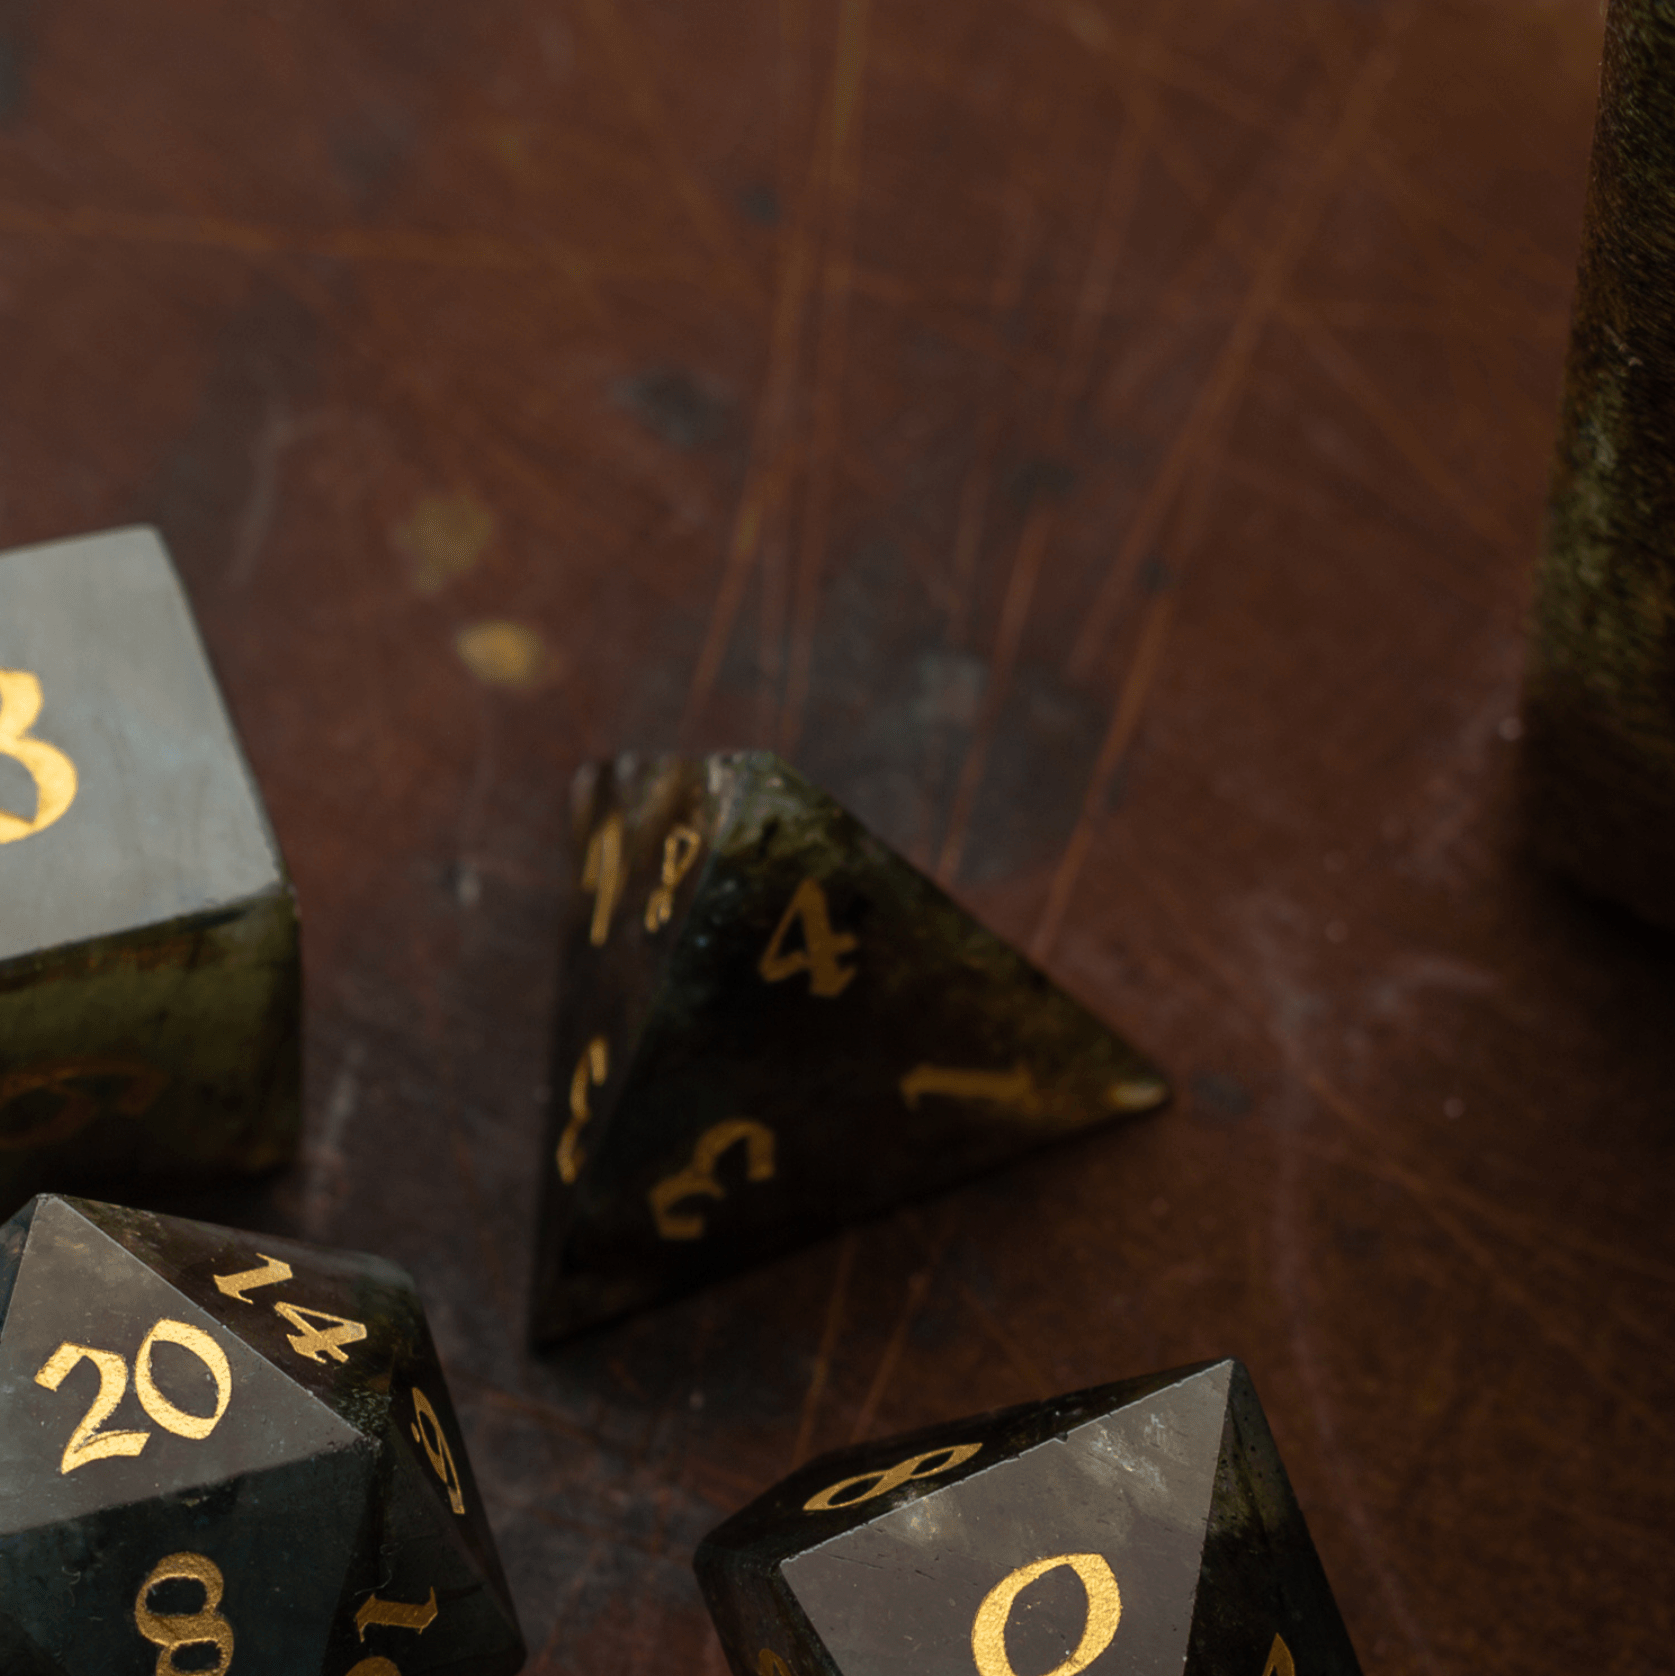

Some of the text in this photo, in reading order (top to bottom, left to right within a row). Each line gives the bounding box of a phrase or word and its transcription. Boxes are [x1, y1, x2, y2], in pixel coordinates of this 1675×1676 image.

[758, 876, 859, 997] 4
[647, 1118, 776, 1240] 3
[213, 1252, 368, 1364] 14
[33, 1317, 233, 1475] 20
[802, 1442, 984, 1511] 8
